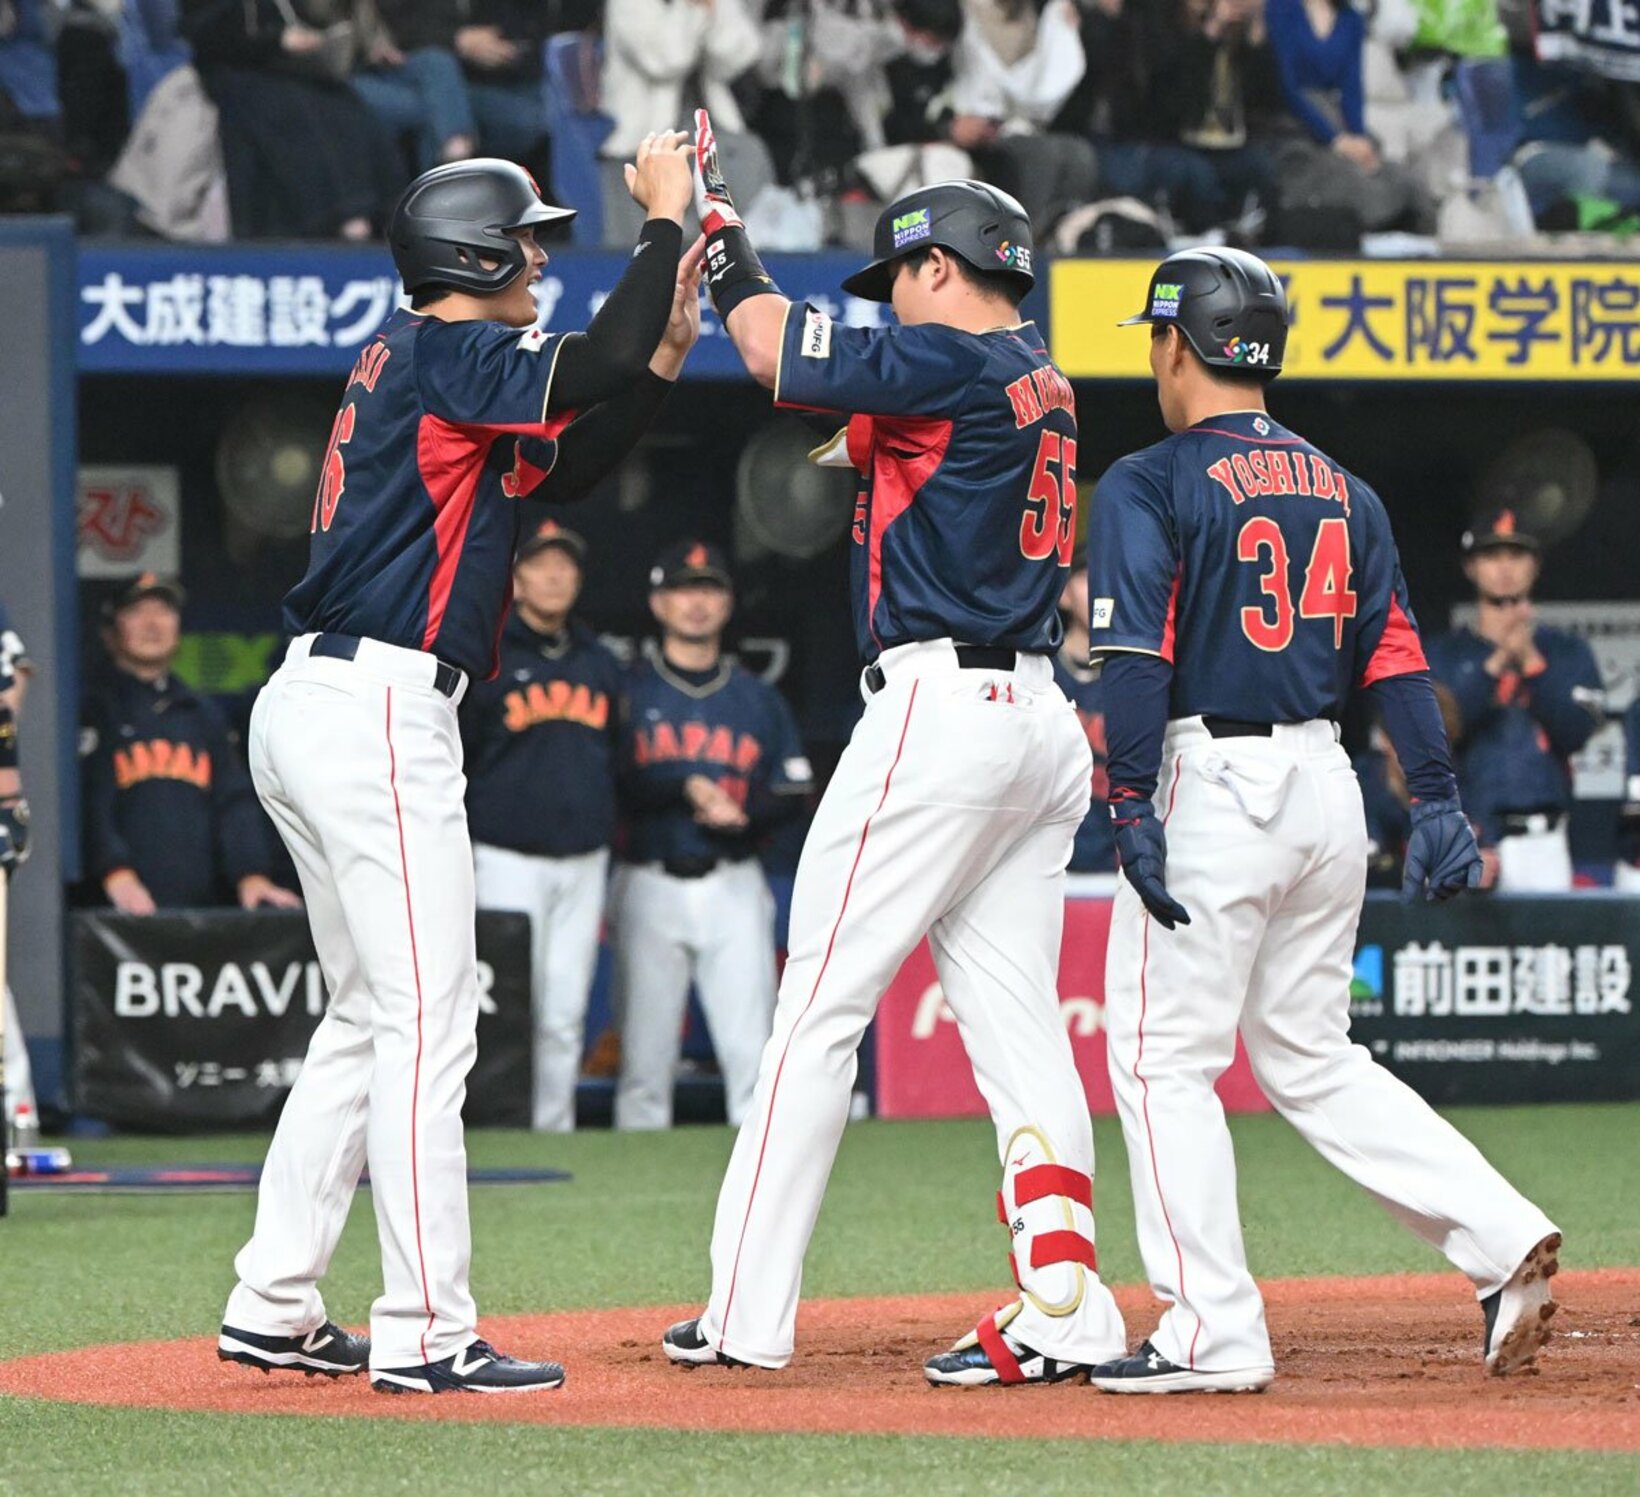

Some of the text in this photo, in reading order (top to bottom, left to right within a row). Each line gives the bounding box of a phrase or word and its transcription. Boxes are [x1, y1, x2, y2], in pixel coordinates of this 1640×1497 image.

[894, 222, 930, 241] NIPPON
[895, 231, 931, 249] EXPRESS
[710, 252, 727, 271] 55
[1016, 245, 1031, 269] 55
[1151, 308, 1178, 317] EXPRESS
[1153, 300, 1180, 309] NIPPON
[1247, 342, 1270, 364] 34
[1019, 428, 1078, 568] 55
[1238, 516, 1357, 652] 34
[1393, 940, 1632, 1017] 前田建設
[115, 960, 324, 1018] BRAVI
[1012, 1217, 1025, 1235] 55
